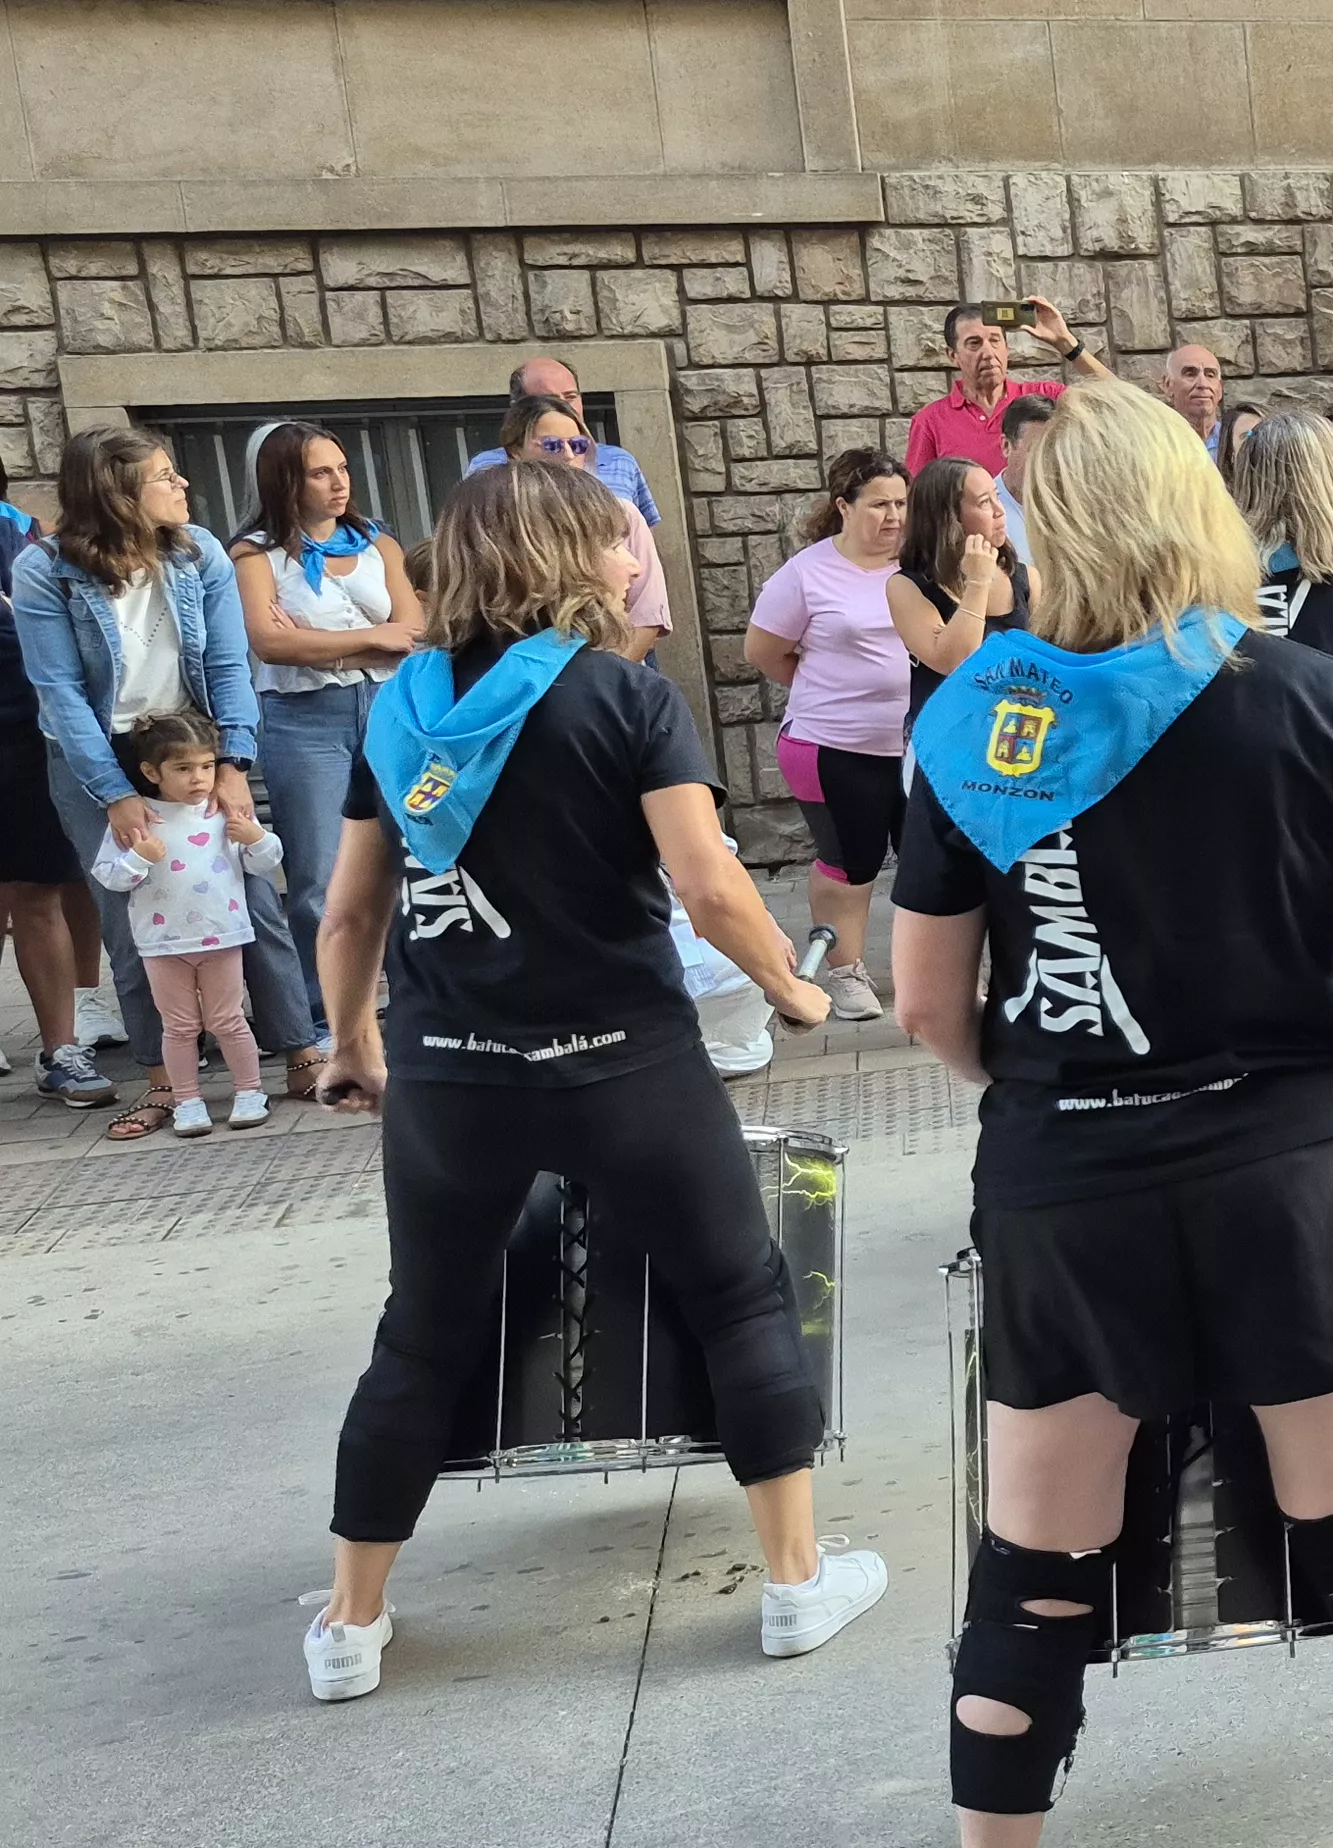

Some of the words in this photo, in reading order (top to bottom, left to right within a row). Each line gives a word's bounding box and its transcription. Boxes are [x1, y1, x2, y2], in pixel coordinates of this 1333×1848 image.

[974, 661, 1005, 692] SAN
[1008, 656, 1074, 704] MATEO
[960, 779, 1056, 801] MONZON
